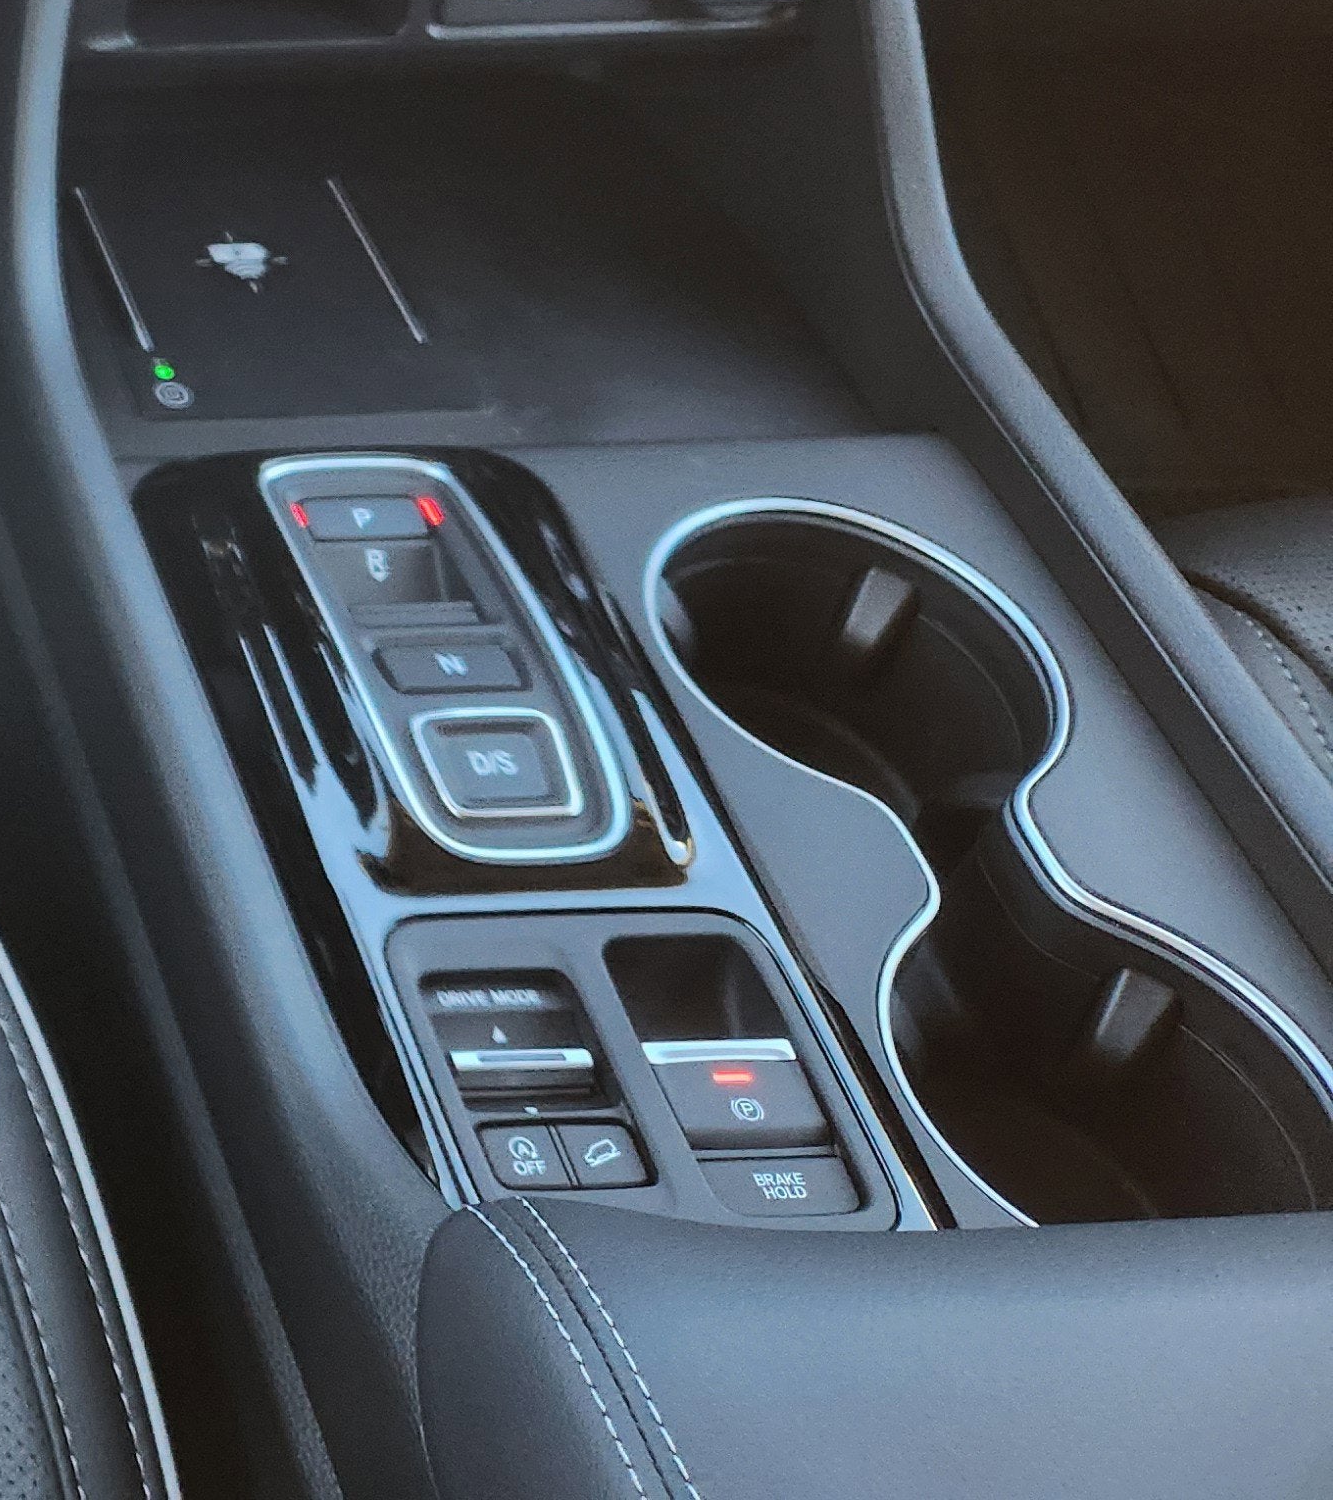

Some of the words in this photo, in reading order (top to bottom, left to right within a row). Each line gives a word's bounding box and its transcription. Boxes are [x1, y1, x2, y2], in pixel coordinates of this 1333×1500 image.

[350, 505, 374, 530] P
[434, 651, 470, 678] N
[466, 748, 519, 777] D/S
[435, 988, 489, 1008] DRIVE
[489, 987, 544, 1008] MODE
[512, 1159, 547, 1176] OFF
[752, 1171, 807, 1188] BRAKE
[762, 1184, 809, 1201] HOLD
